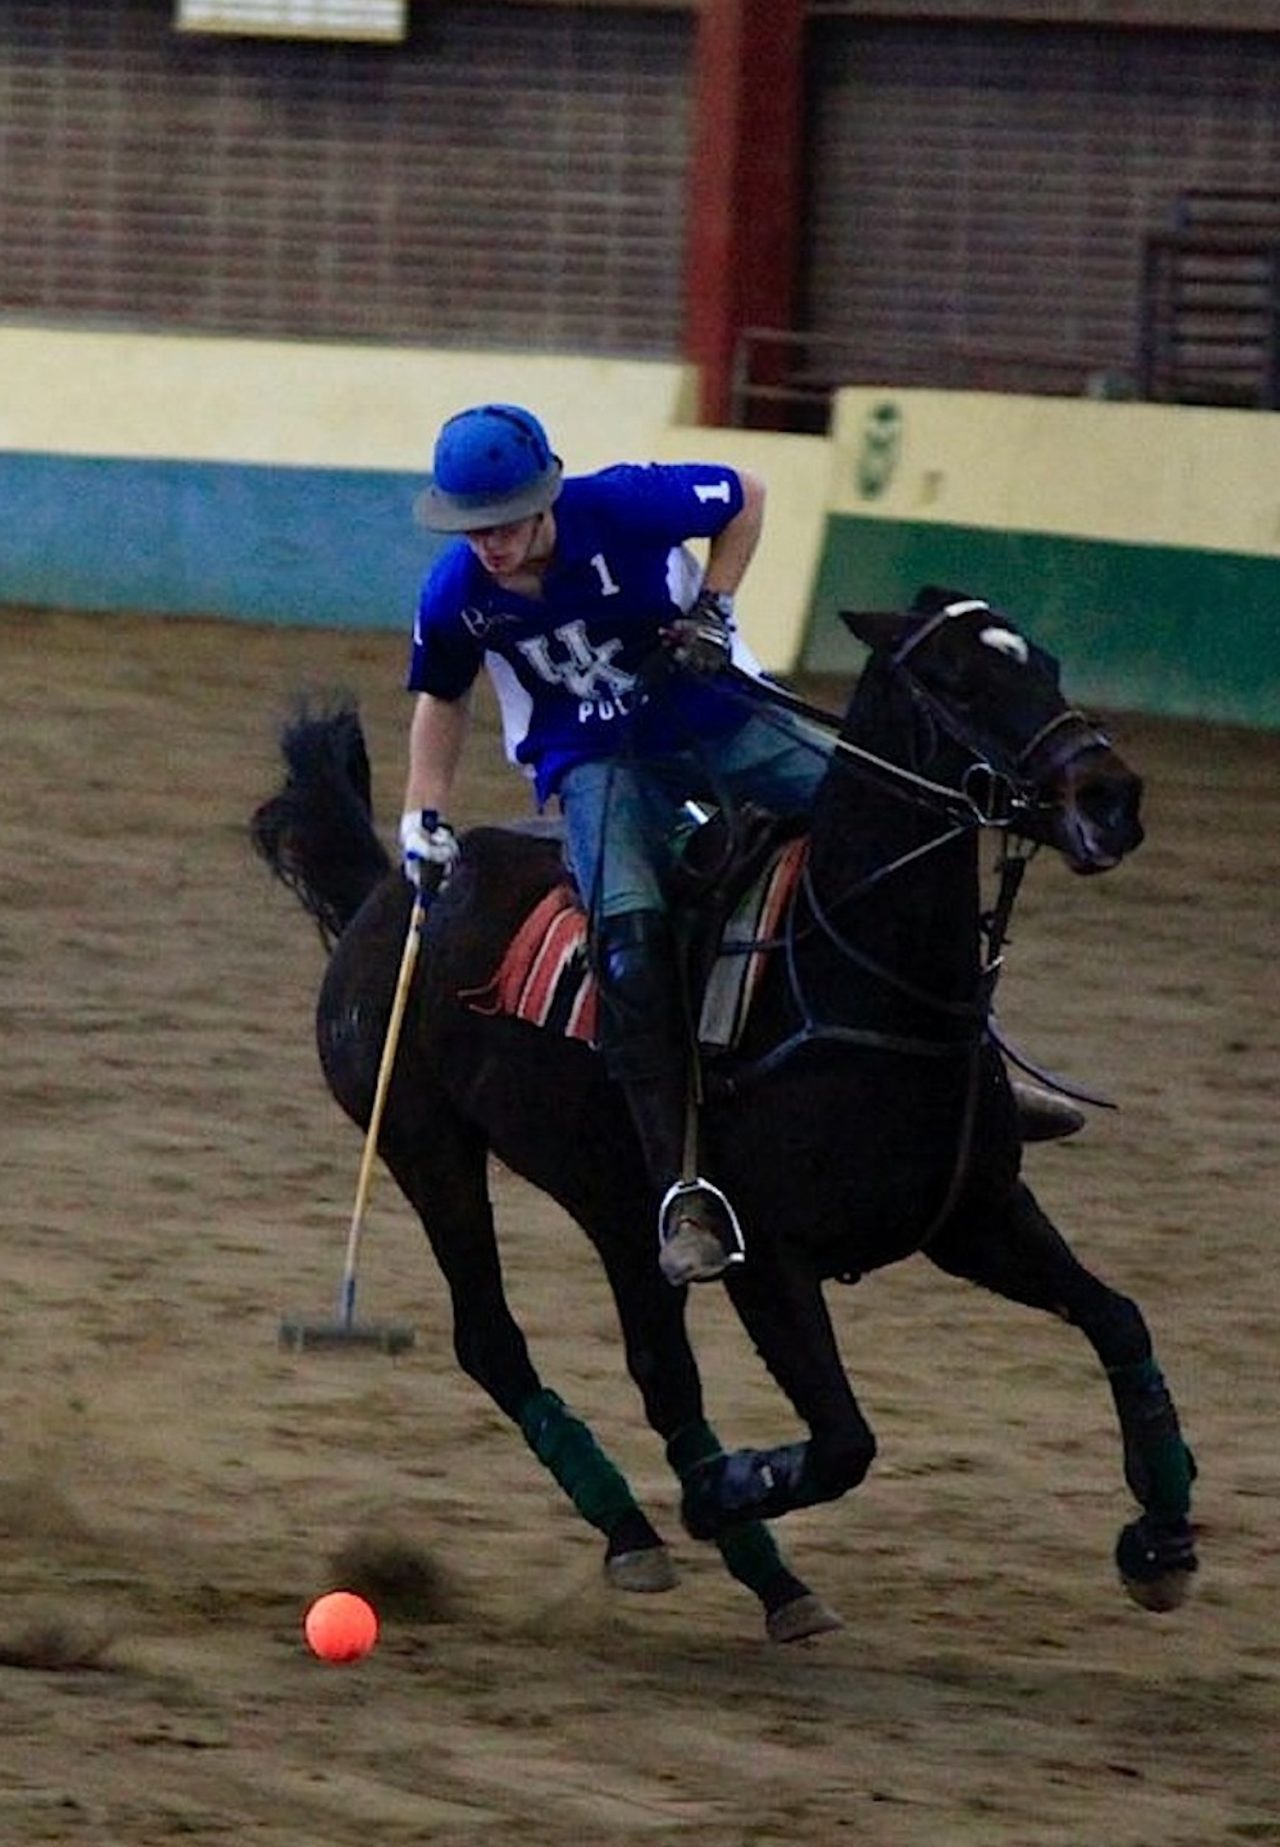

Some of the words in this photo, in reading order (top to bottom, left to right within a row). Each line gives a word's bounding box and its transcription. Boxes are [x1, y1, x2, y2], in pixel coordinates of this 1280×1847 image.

[693, 480, 731, 504] 1
[590, 552, 620, 596] 1
[515, 619, 637, 700] UK
